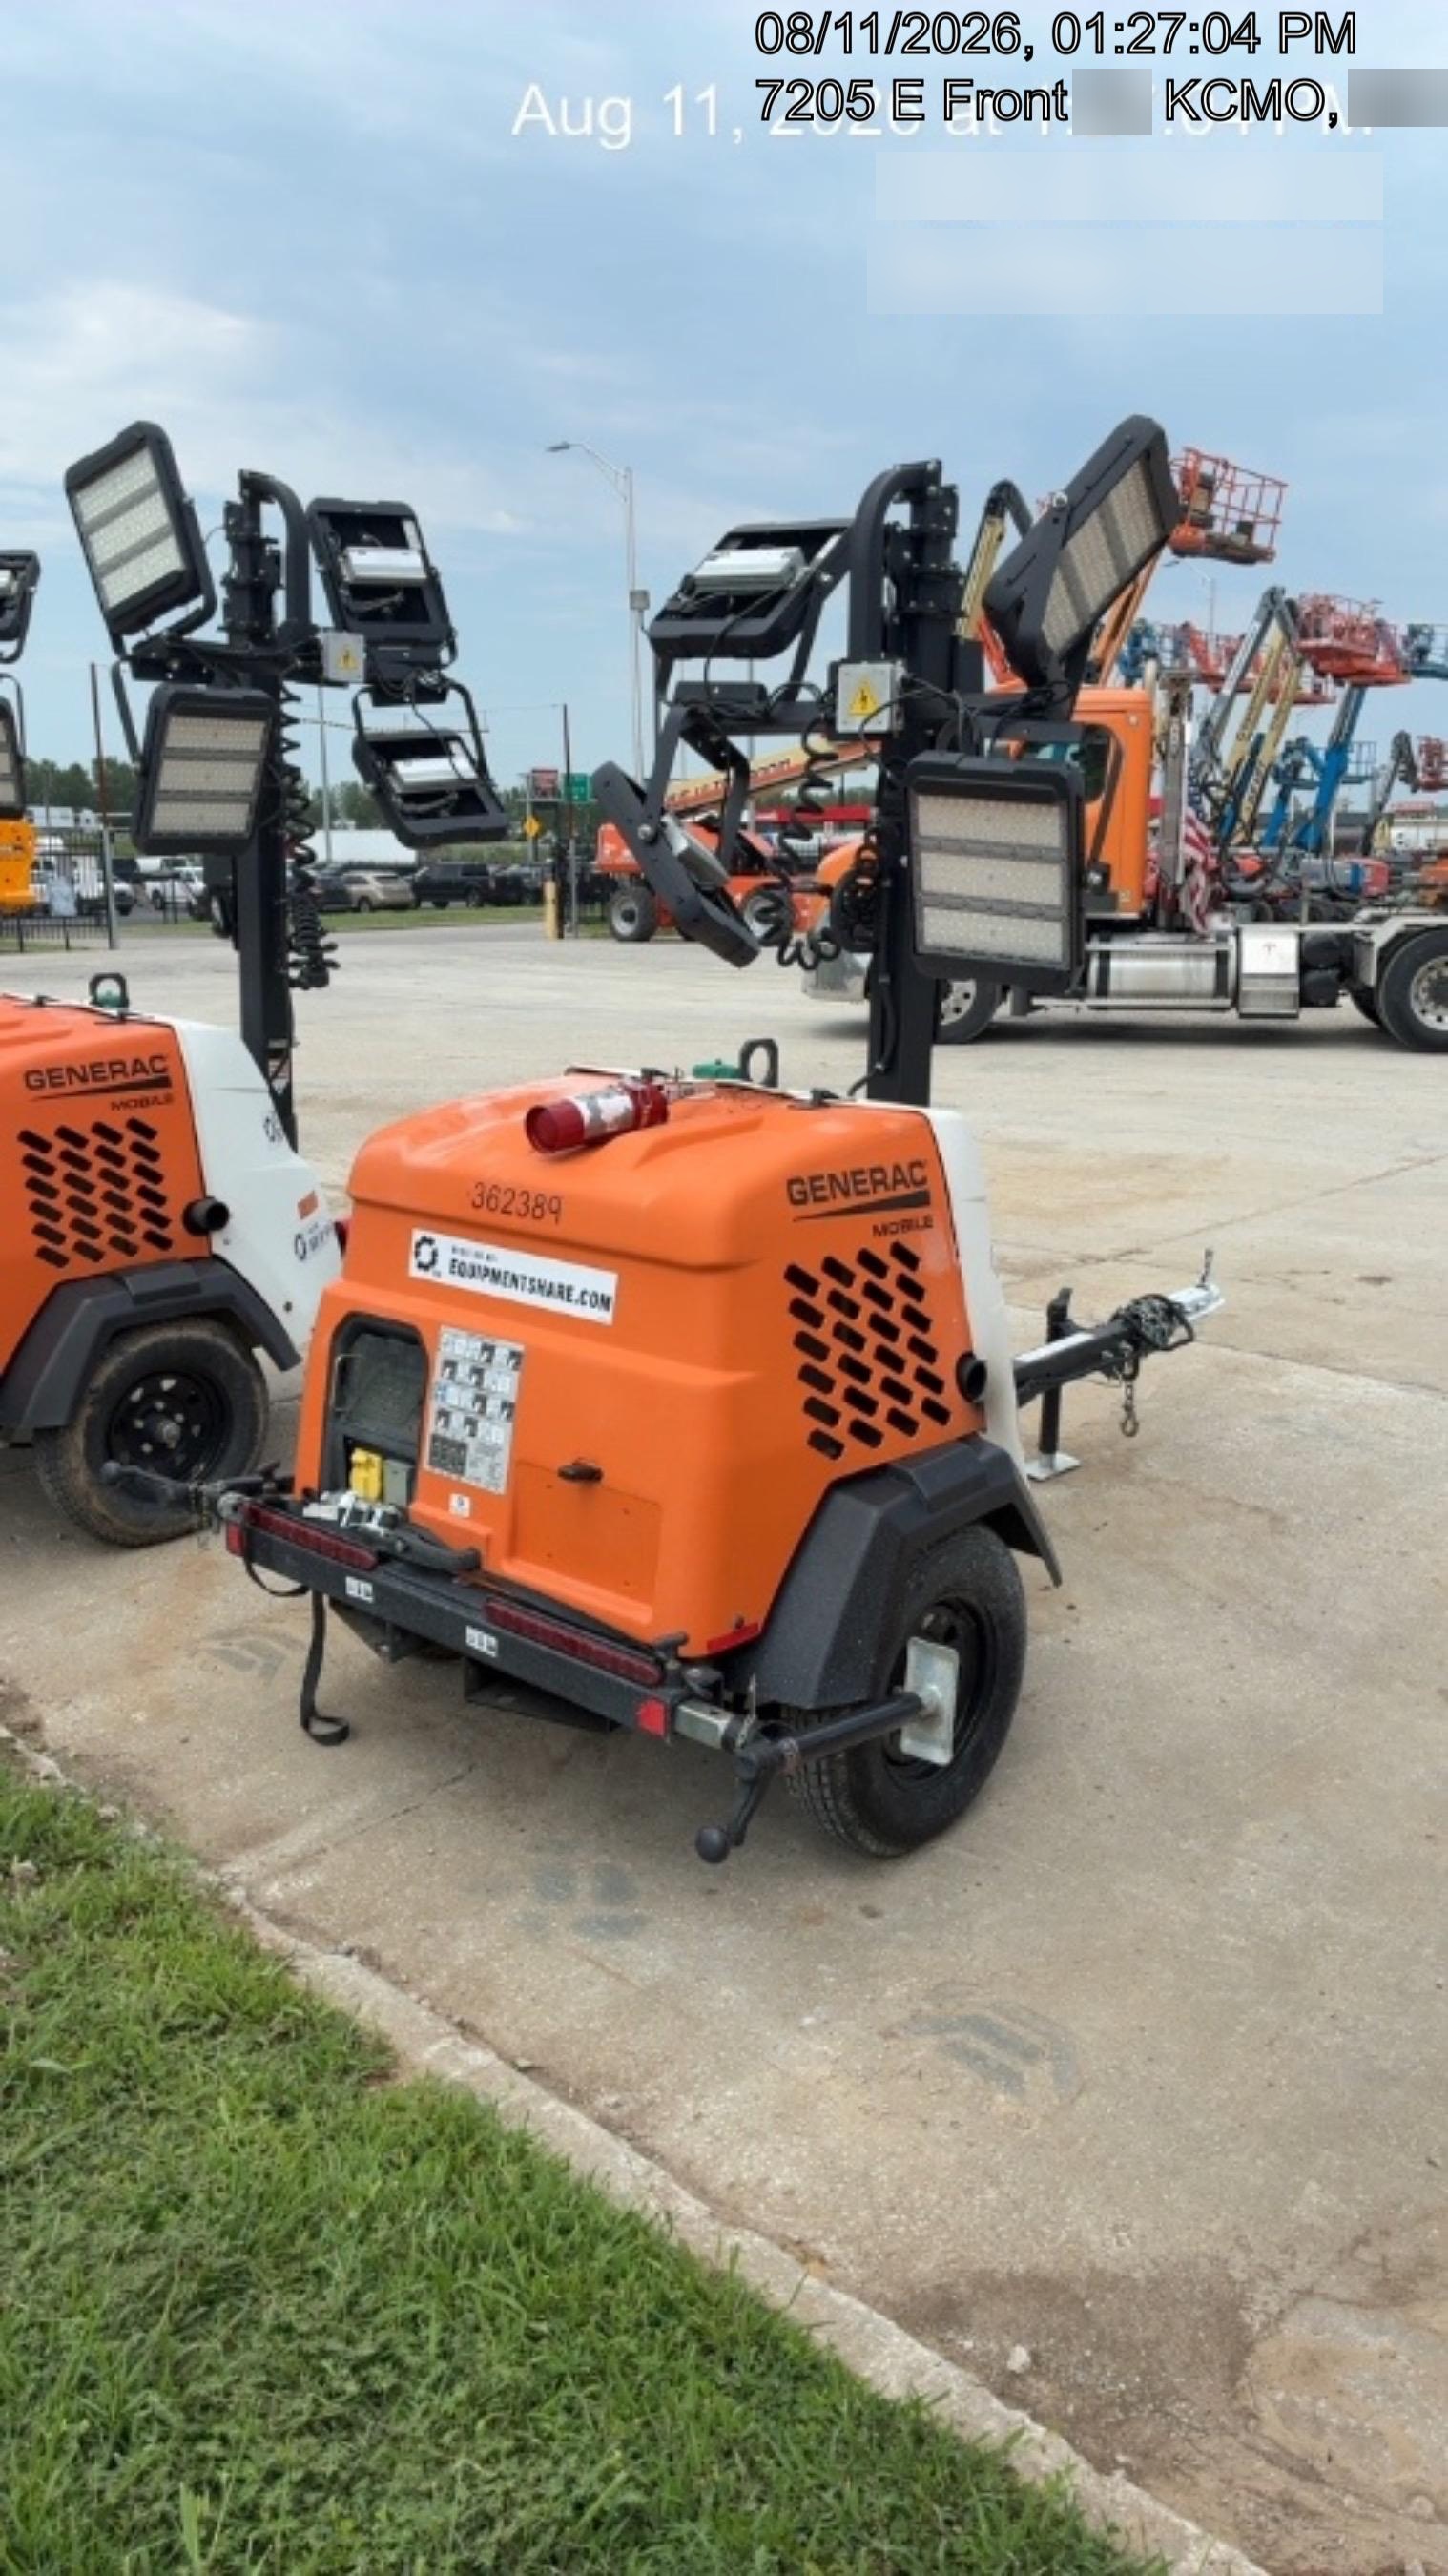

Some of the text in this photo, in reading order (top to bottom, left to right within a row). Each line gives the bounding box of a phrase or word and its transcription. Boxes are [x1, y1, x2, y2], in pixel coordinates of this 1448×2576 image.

[24, 1054, 170, 1091] GENERAC
[110, 1092, 175, 1112] MOBILE
[786, 1159, 929, 1206] GENERAC
[471, 1181, 564, 1225] 362389
[872, 1215, 935, 1238] MOBILE
[448, 1257, 613, 1312] EQUIPMENTSHARE.COM
